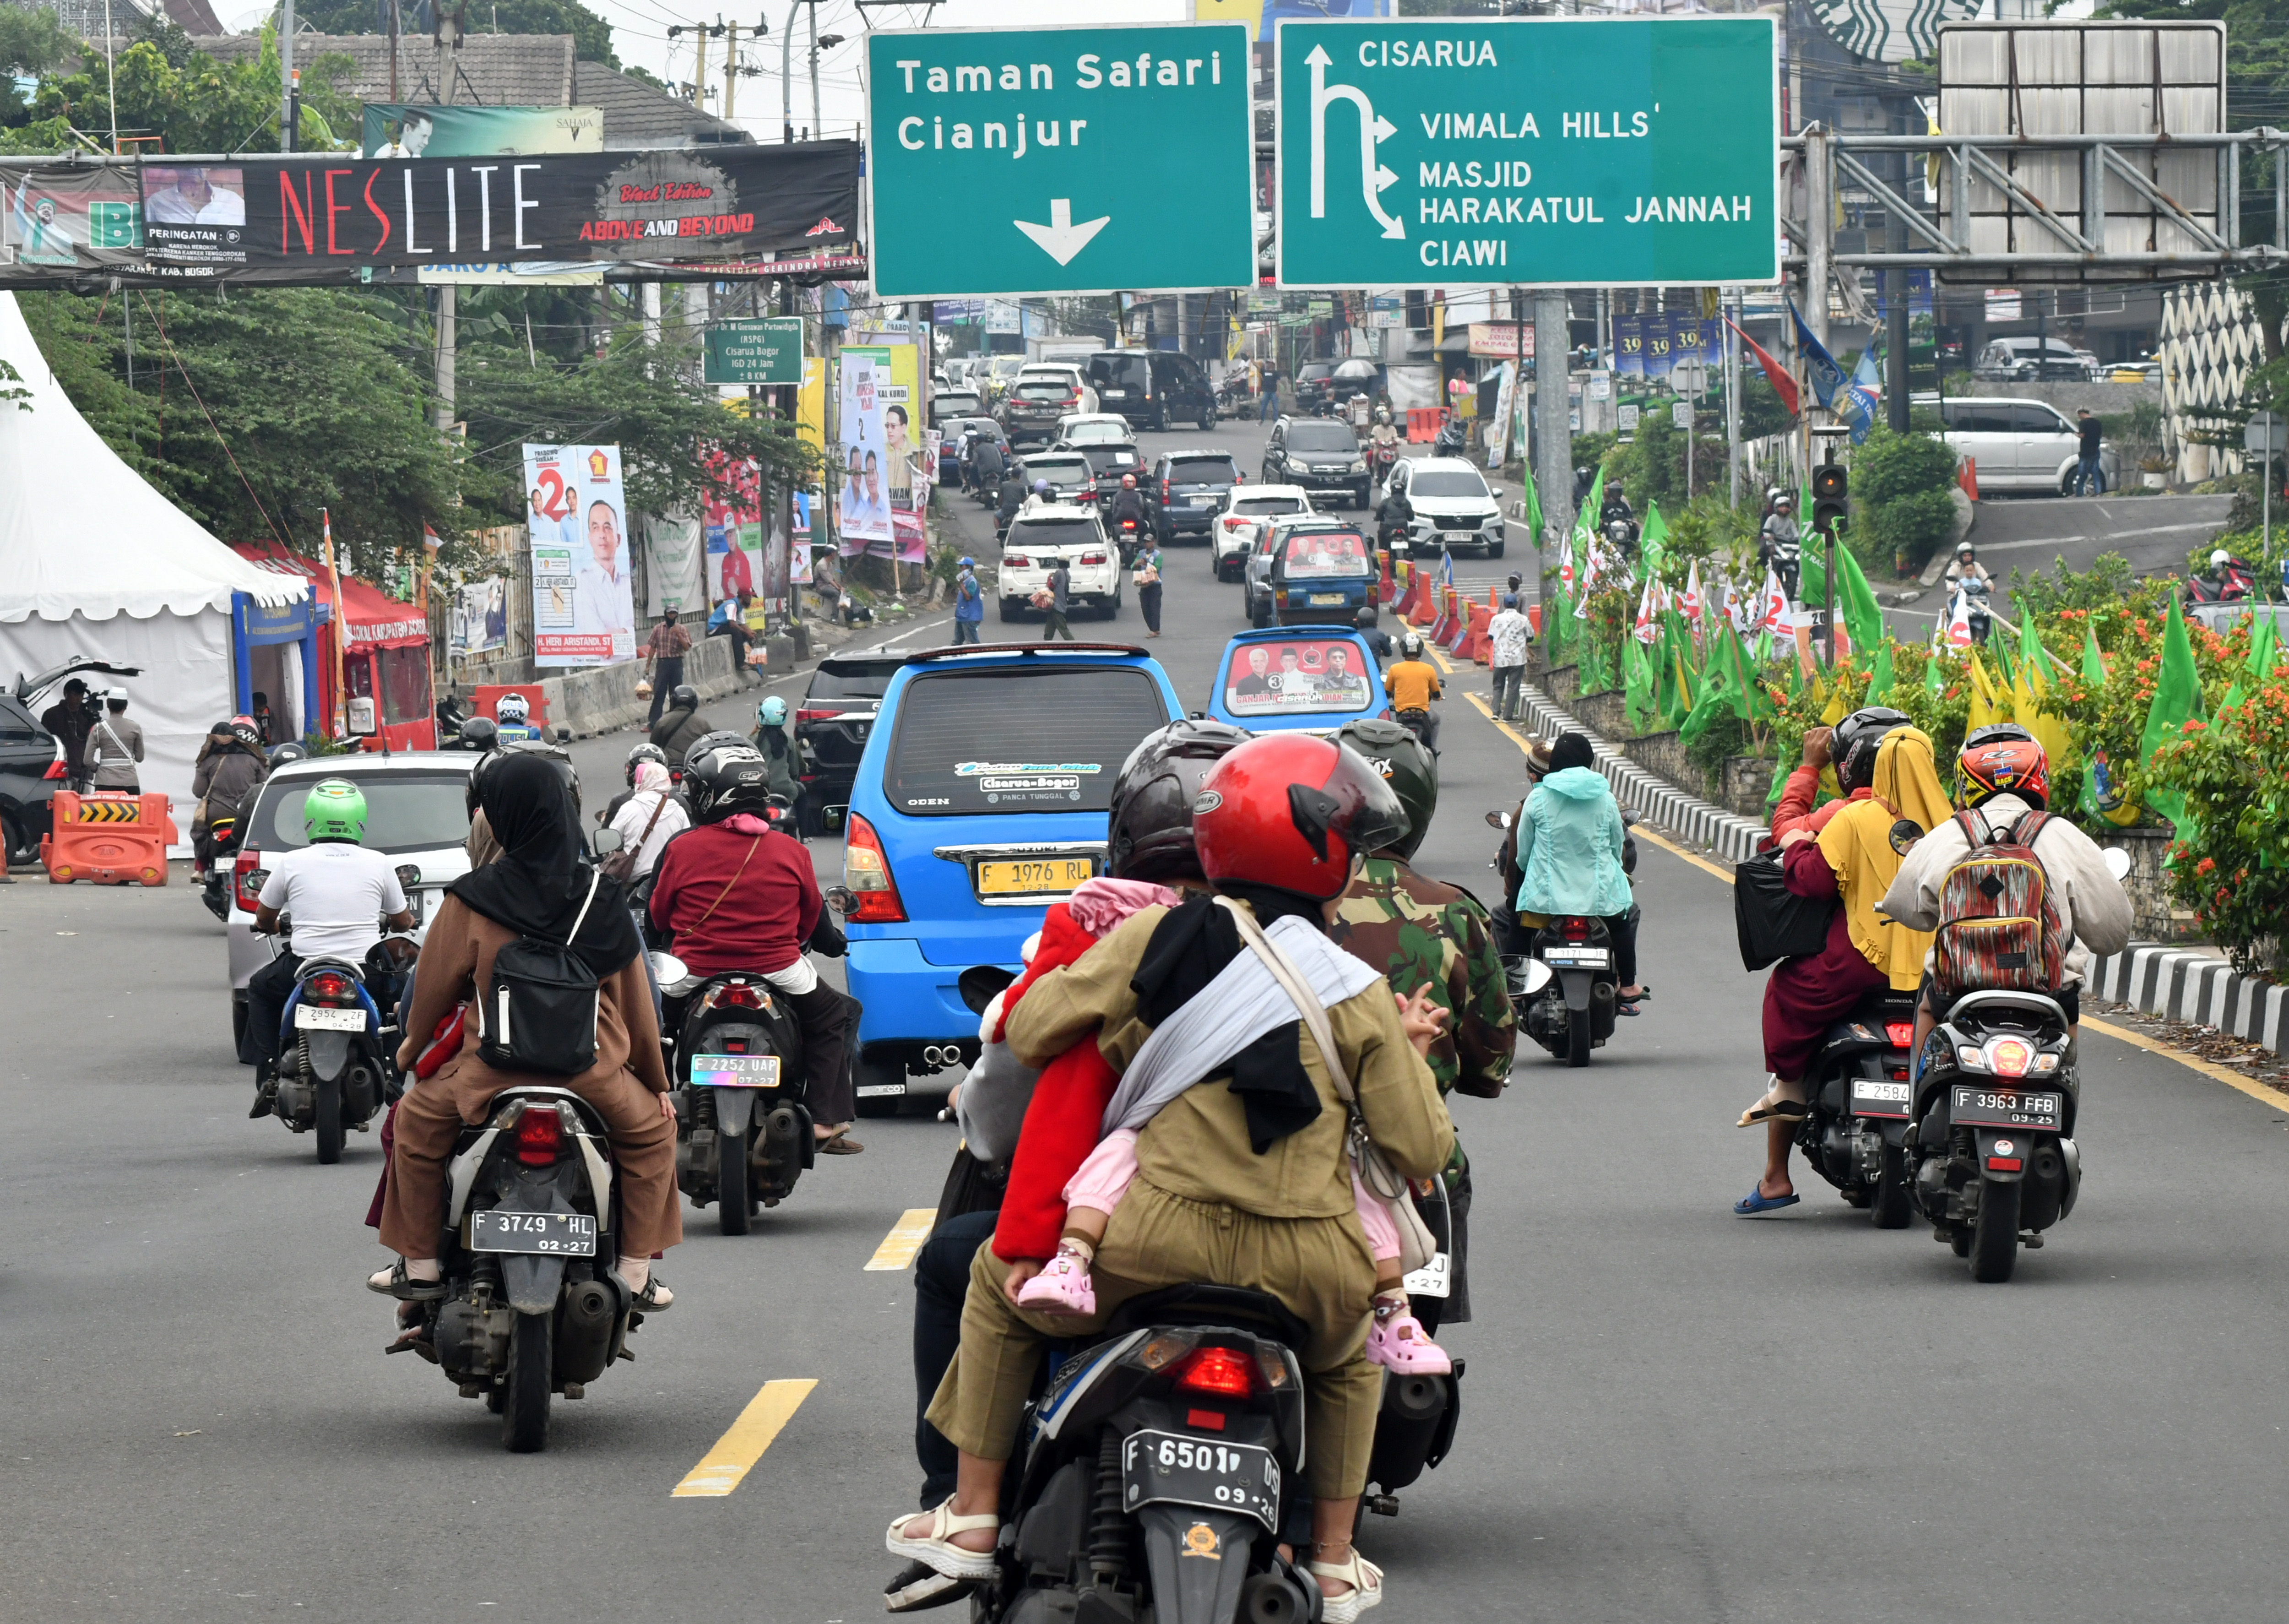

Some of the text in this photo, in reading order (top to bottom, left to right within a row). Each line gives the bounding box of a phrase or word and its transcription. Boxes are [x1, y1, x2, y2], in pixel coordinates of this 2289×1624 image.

[1358, 40, 1497, 68] CISARUA
[896, 51, 1220, 93] Taman Safari
[557, 119, 593, 128] SAHAJA
[1420, 113, 1540, 139] VIMALA
[898, 113, 1087, 159] Cianjur
[1420, 161, 1531, 188] MASJID
[619, 182, 713, 203] Black Edition
[1420, 195, 1751, 223] HARAKATUL JANNAH
[149, 229, 217, 240] PERINGATAN
[19, 253, 78, 265] Komando
[1420, 240, 1507, 267] CIAWI
[161, 266, 183, 276] KAB.
[764, 261, 818, 273] GERINDRA
[824, 258, 866, 269] MENANG
[740, 335, 765, 344] (RSPG)
[725, 347, 779, 358] Cisarua Bogor
[732, 359, 774, 368] IGD 24 Jam
[755, 372, 767, 380] KM
[890, 389, 907, 398] KURDI
[858, 417, 865, 441] 2
[537, 468, 568, 522] 2
[1765, 595, 1783, 626] 2
[545, 636, 562, 646] HERI
[1236, 693, 1271, 704] GANJAR
[984, 777, 1076, 788] Cisarua-Bogor
[1996, 776, 2013, 785] RACE
[908, 798, 949, 806] ODEN
[982, 862, 1088, 883] F 1976 RL
[298, 1006, 363, 1020] F 2954 ZF
[694, 1058, 777, 1071] F 2252 UAP
[1857, 1083, 1908, 1100] F 2584
[1958, 1092, 2054, 1112] F 3963 FFB
[475, 1213, 592, 1235] F 3749 HL
[1127, 1440, 1139, 1472] F
